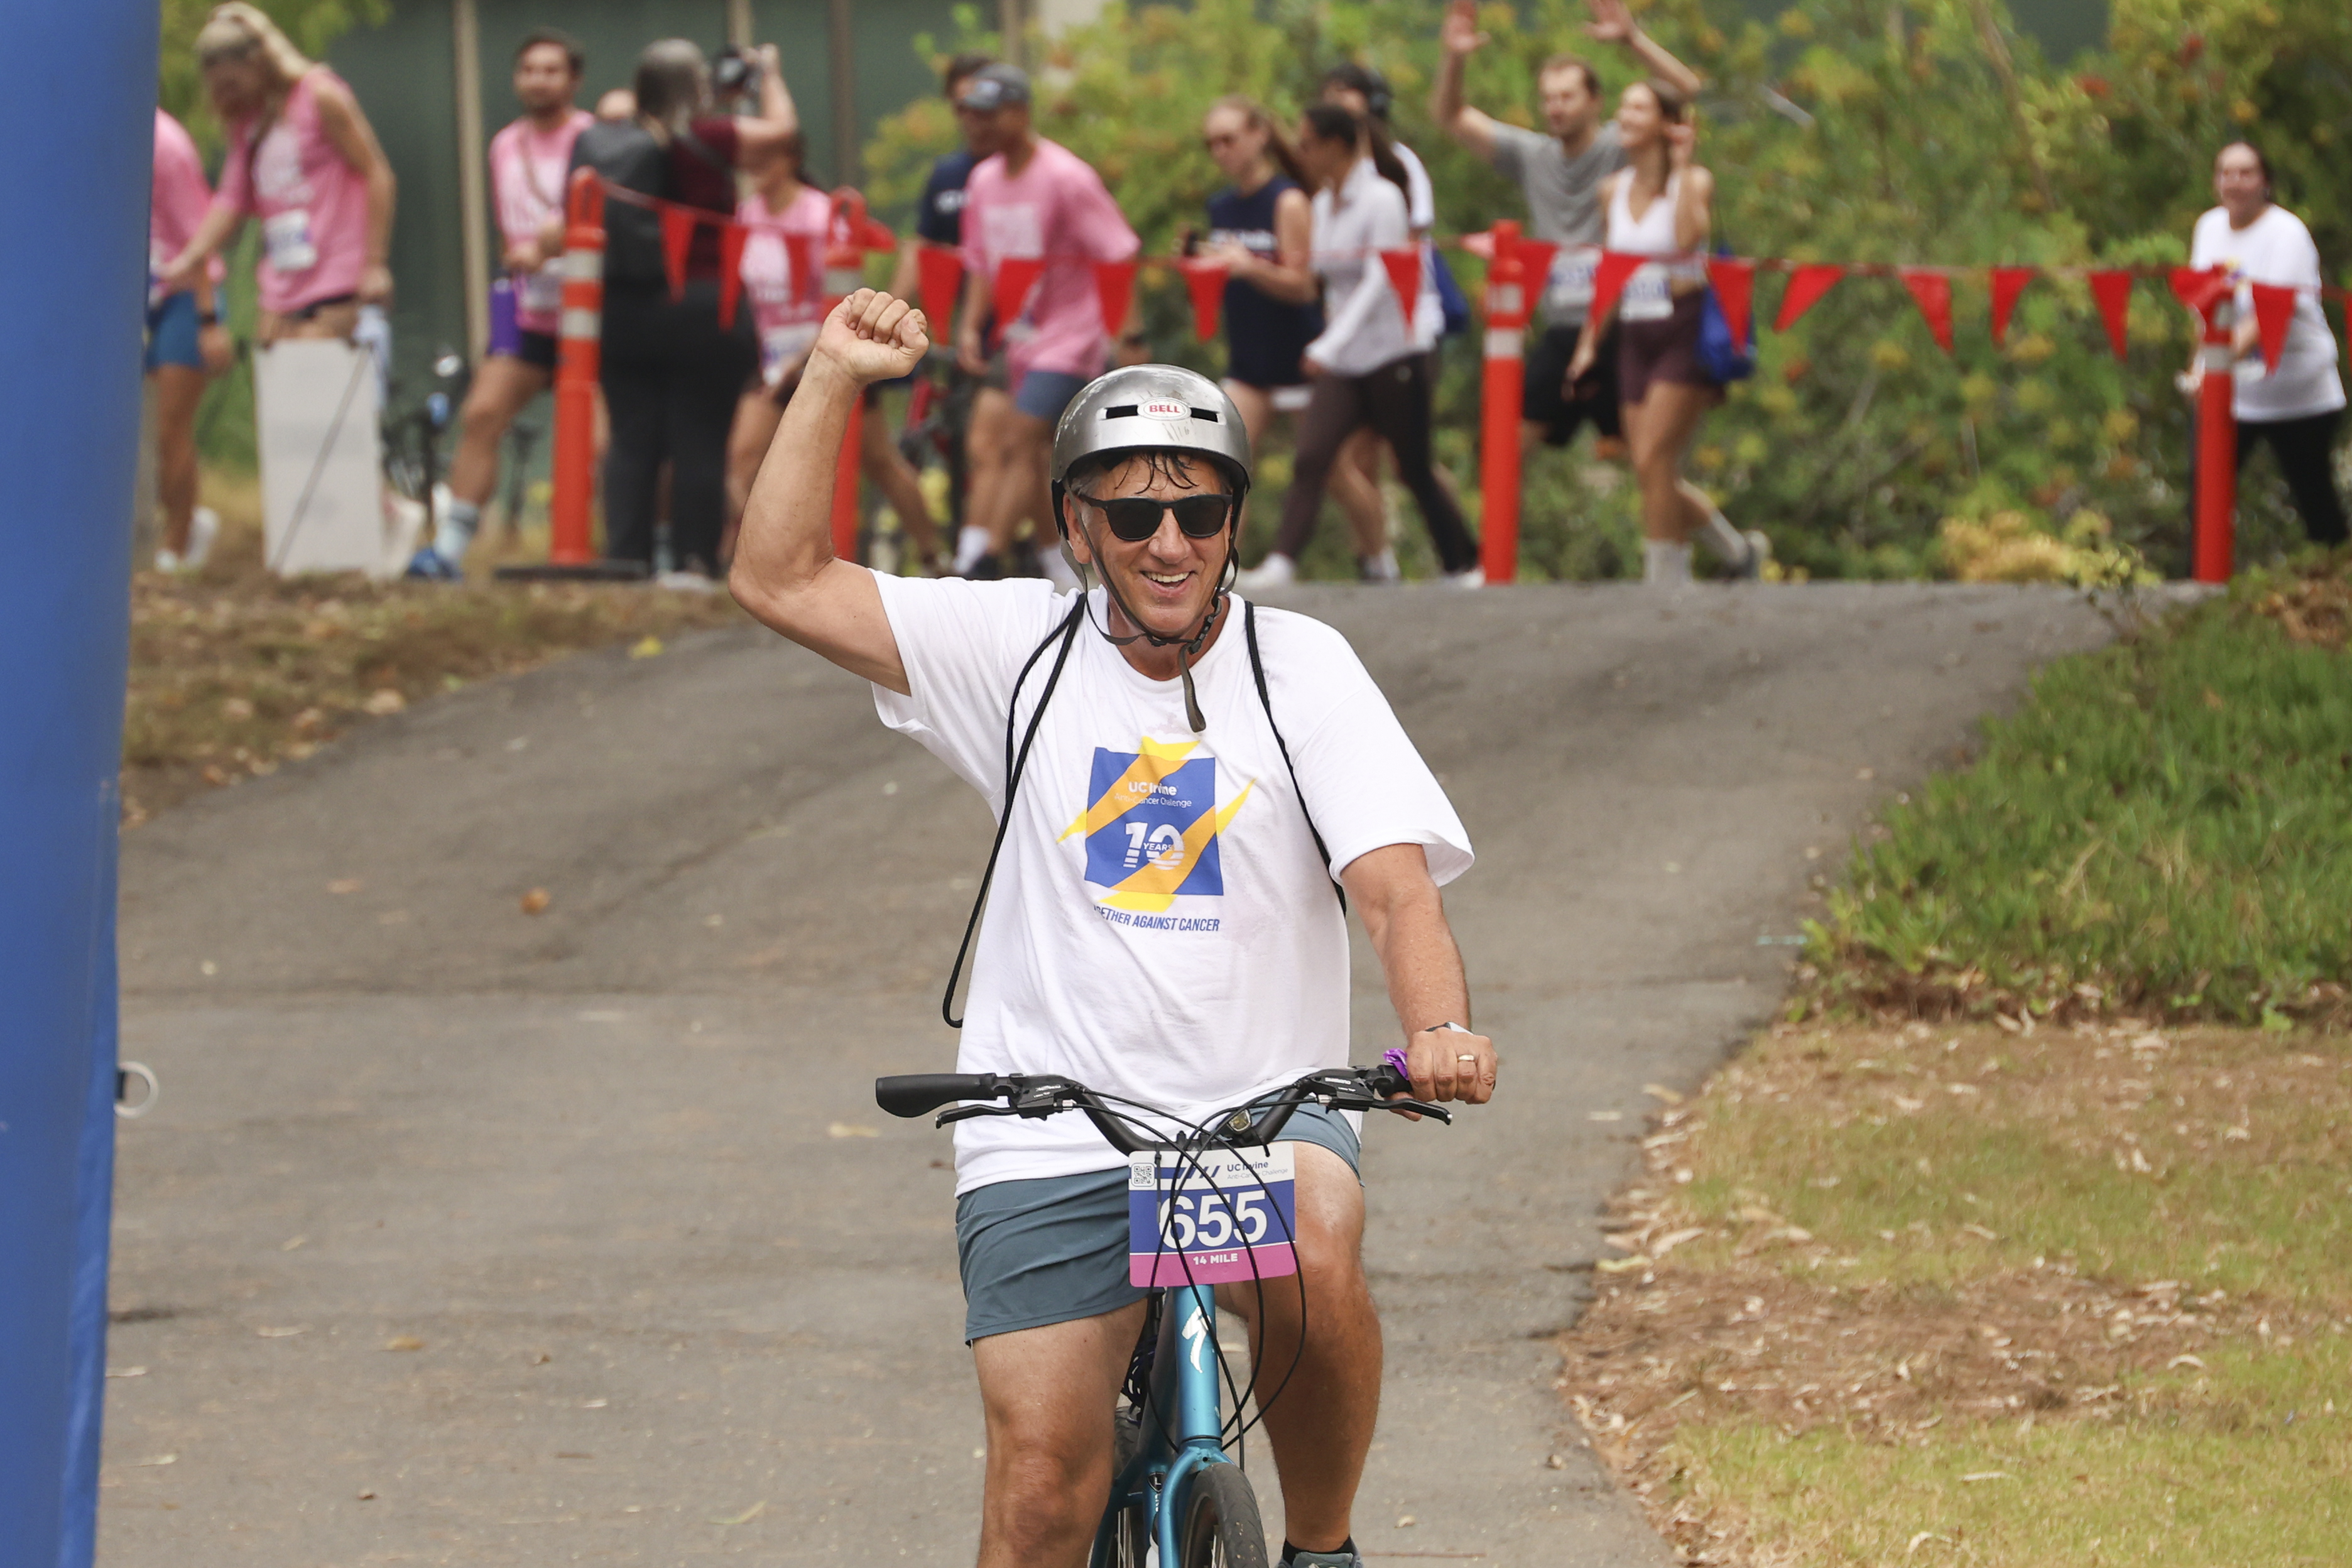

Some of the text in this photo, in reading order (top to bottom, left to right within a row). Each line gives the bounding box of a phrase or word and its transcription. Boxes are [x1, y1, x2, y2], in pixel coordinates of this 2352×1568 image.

[1150, 405, 1180, 413] BELL
[1128, 781, 1148, 793] UC
[1123, 822, 1184, 870] 10
[1093, 905, 1220, 932] ETHER AGAINST CANCER
[1227, 1163, 1241, 1172] UC
[1159, 1190, 1267, 1249] 655
[1193, 1253, 1238, 1265] 14 MILE
